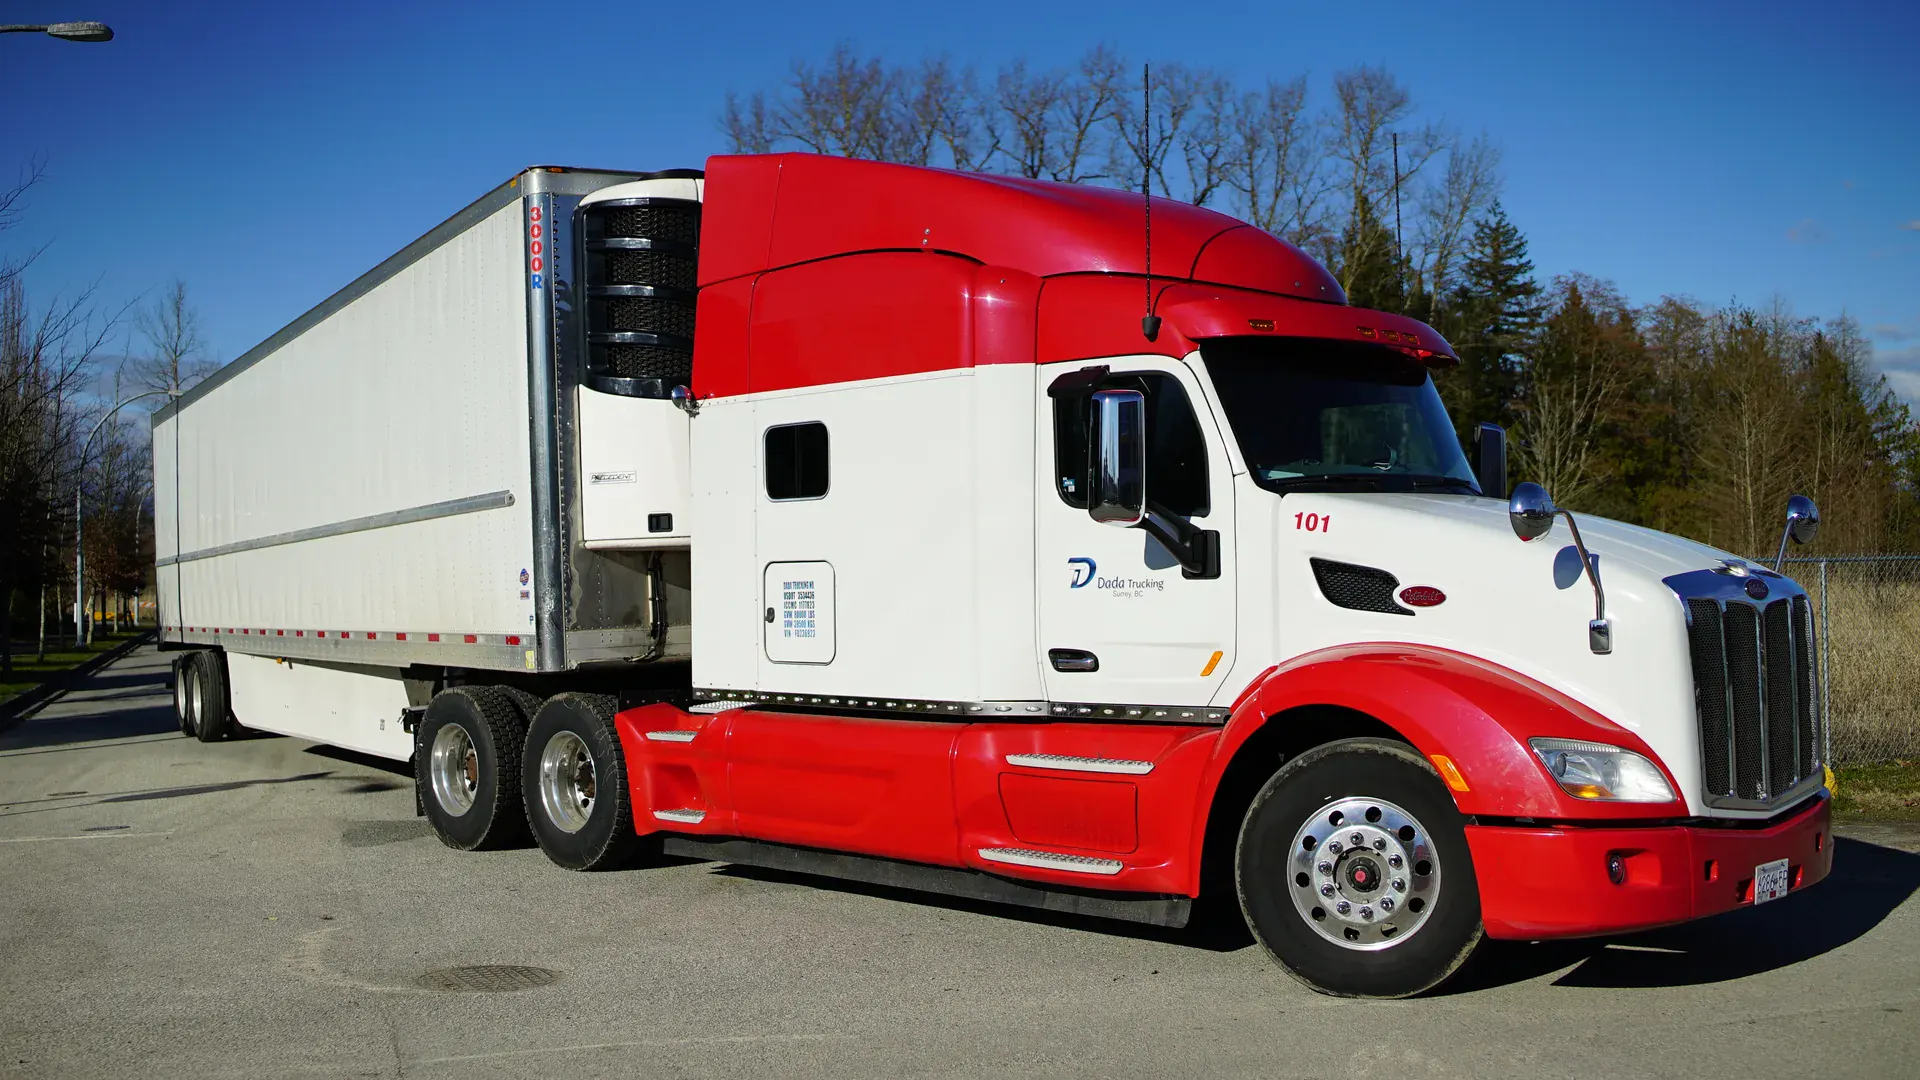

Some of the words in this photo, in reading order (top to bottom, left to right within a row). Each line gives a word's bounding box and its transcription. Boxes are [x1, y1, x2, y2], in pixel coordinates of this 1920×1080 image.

[530, 206, 543, 289] 3000R
[1294, 511, 1330, 533] 101
[1097, 576, 1125, 589] Dada
[1127, 578, 1164, 592] Trucking
[1112, 590, 1133, 599] Surrey,
[1134, 590, 1144, 598] BC
[1404, 589, 1442, 601] Peterbilt
